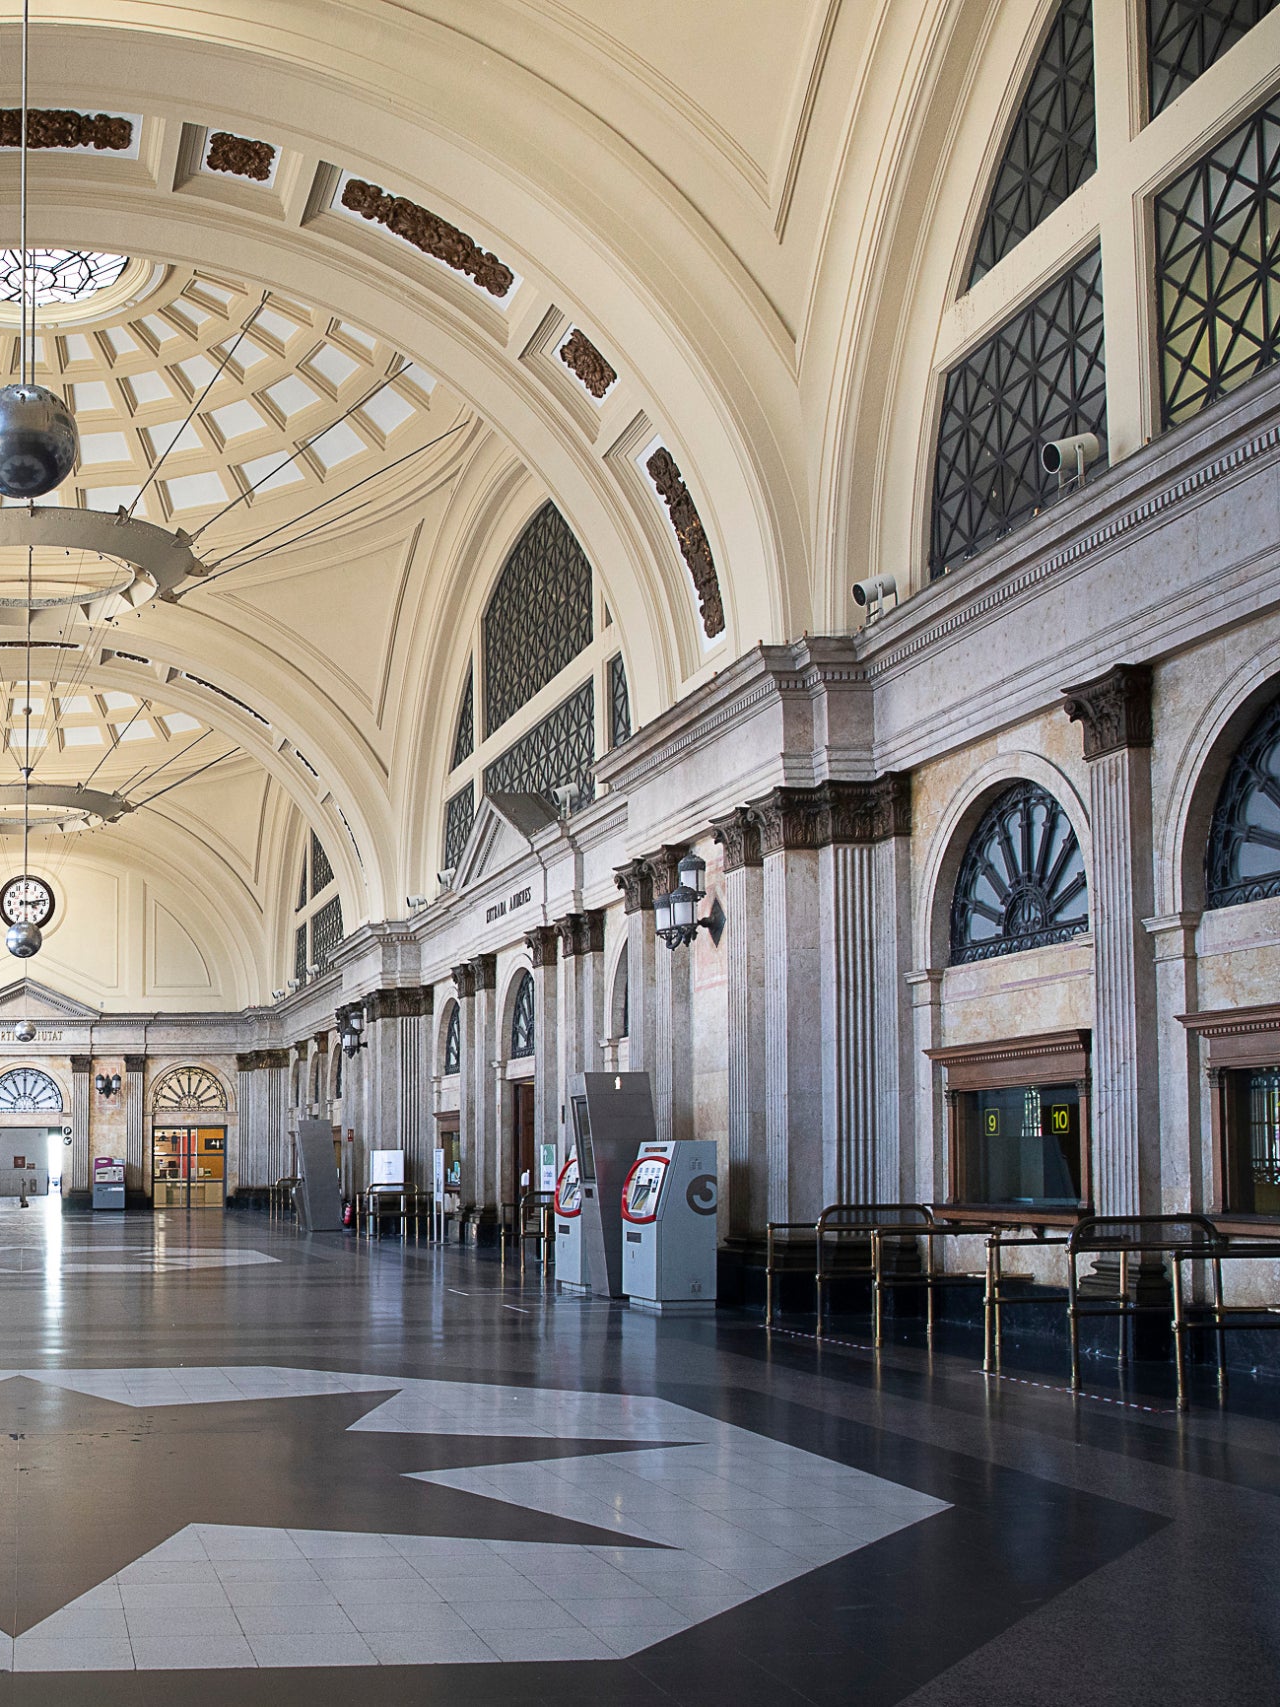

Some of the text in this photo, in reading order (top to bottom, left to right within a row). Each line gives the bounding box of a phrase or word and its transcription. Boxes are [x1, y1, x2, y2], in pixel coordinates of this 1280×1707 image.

[34, 1031, 63, 1041] IUTAT
[988, 1114, 997, 1132] 9
[1053, 1110, 1068, 1129] 10
